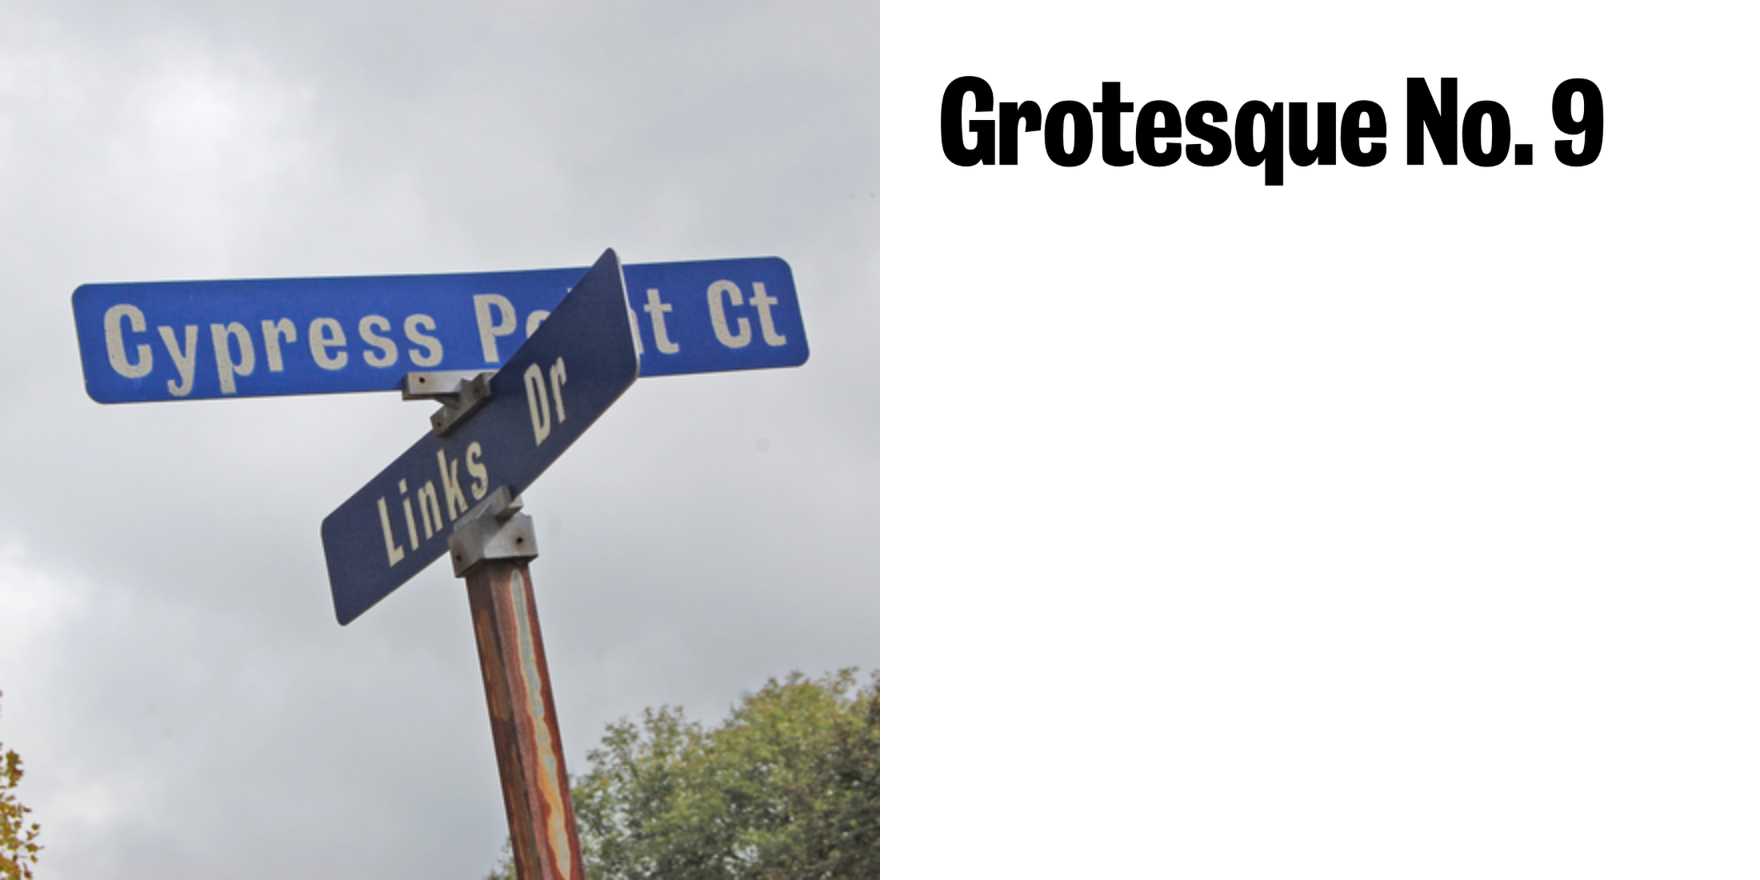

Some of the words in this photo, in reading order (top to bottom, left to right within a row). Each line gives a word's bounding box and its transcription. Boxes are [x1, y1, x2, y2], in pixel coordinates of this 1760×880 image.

[103, 303, 444, 398] Cypress
[706, 279, 788, 350] Ct
[377, 440, 489, 569] Links
[523, 355, 569, 448] Dr
